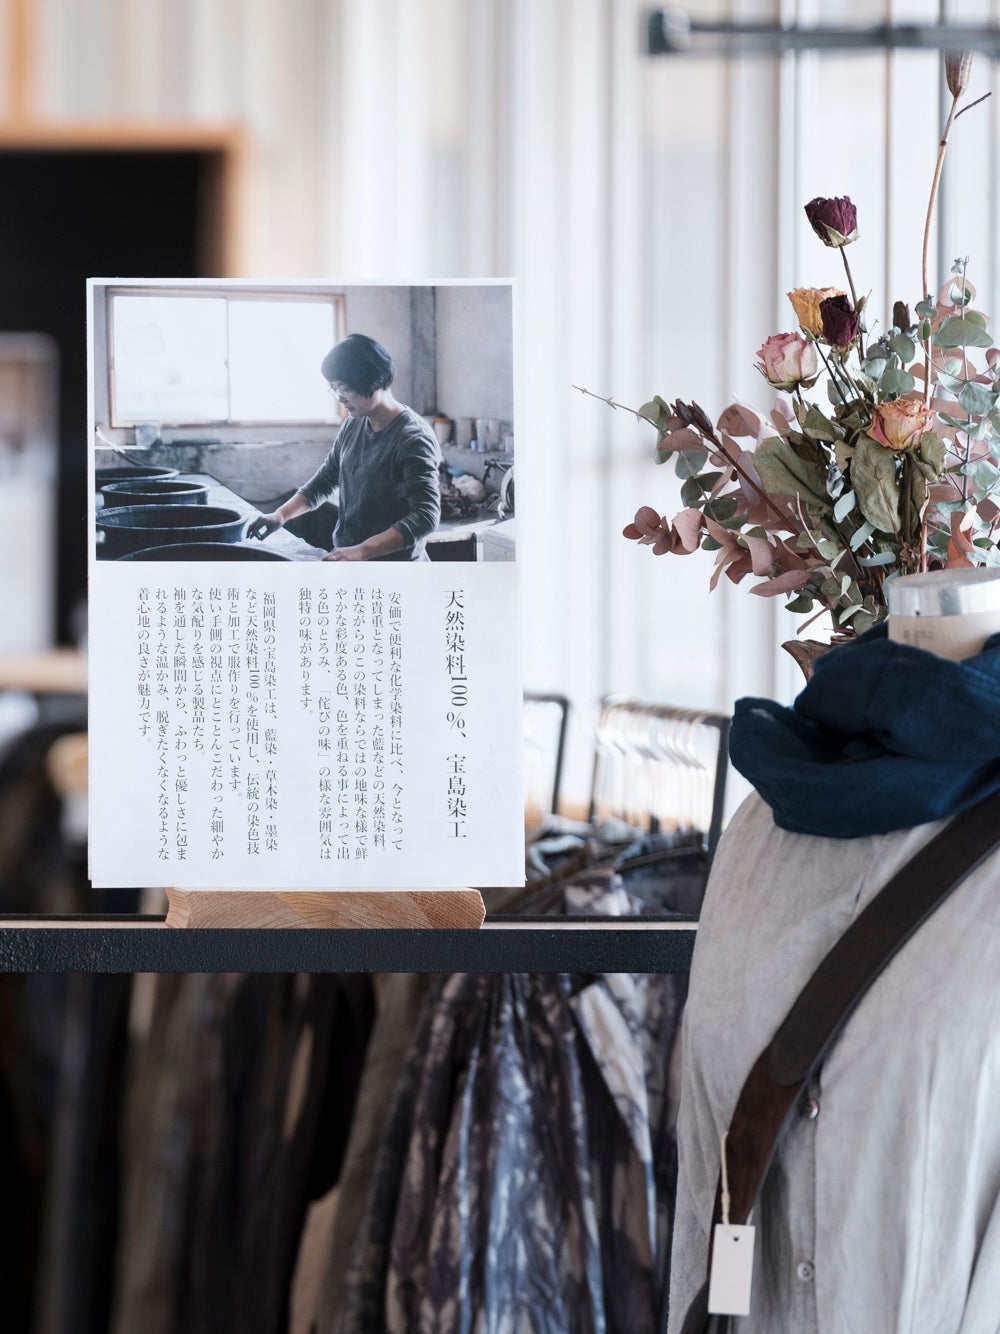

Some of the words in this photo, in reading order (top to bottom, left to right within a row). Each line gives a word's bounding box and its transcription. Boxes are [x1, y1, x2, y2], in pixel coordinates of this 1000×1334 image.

[137, 587, 152, 743] 着心地の良さが魅力です。
[191, 587, 206, 757] な気配りを感じる製品たち。
[227, 587, 243, 798] 術と加工で服作りを行っています。
[298, 587, 314, 716] 独特の味があります。
